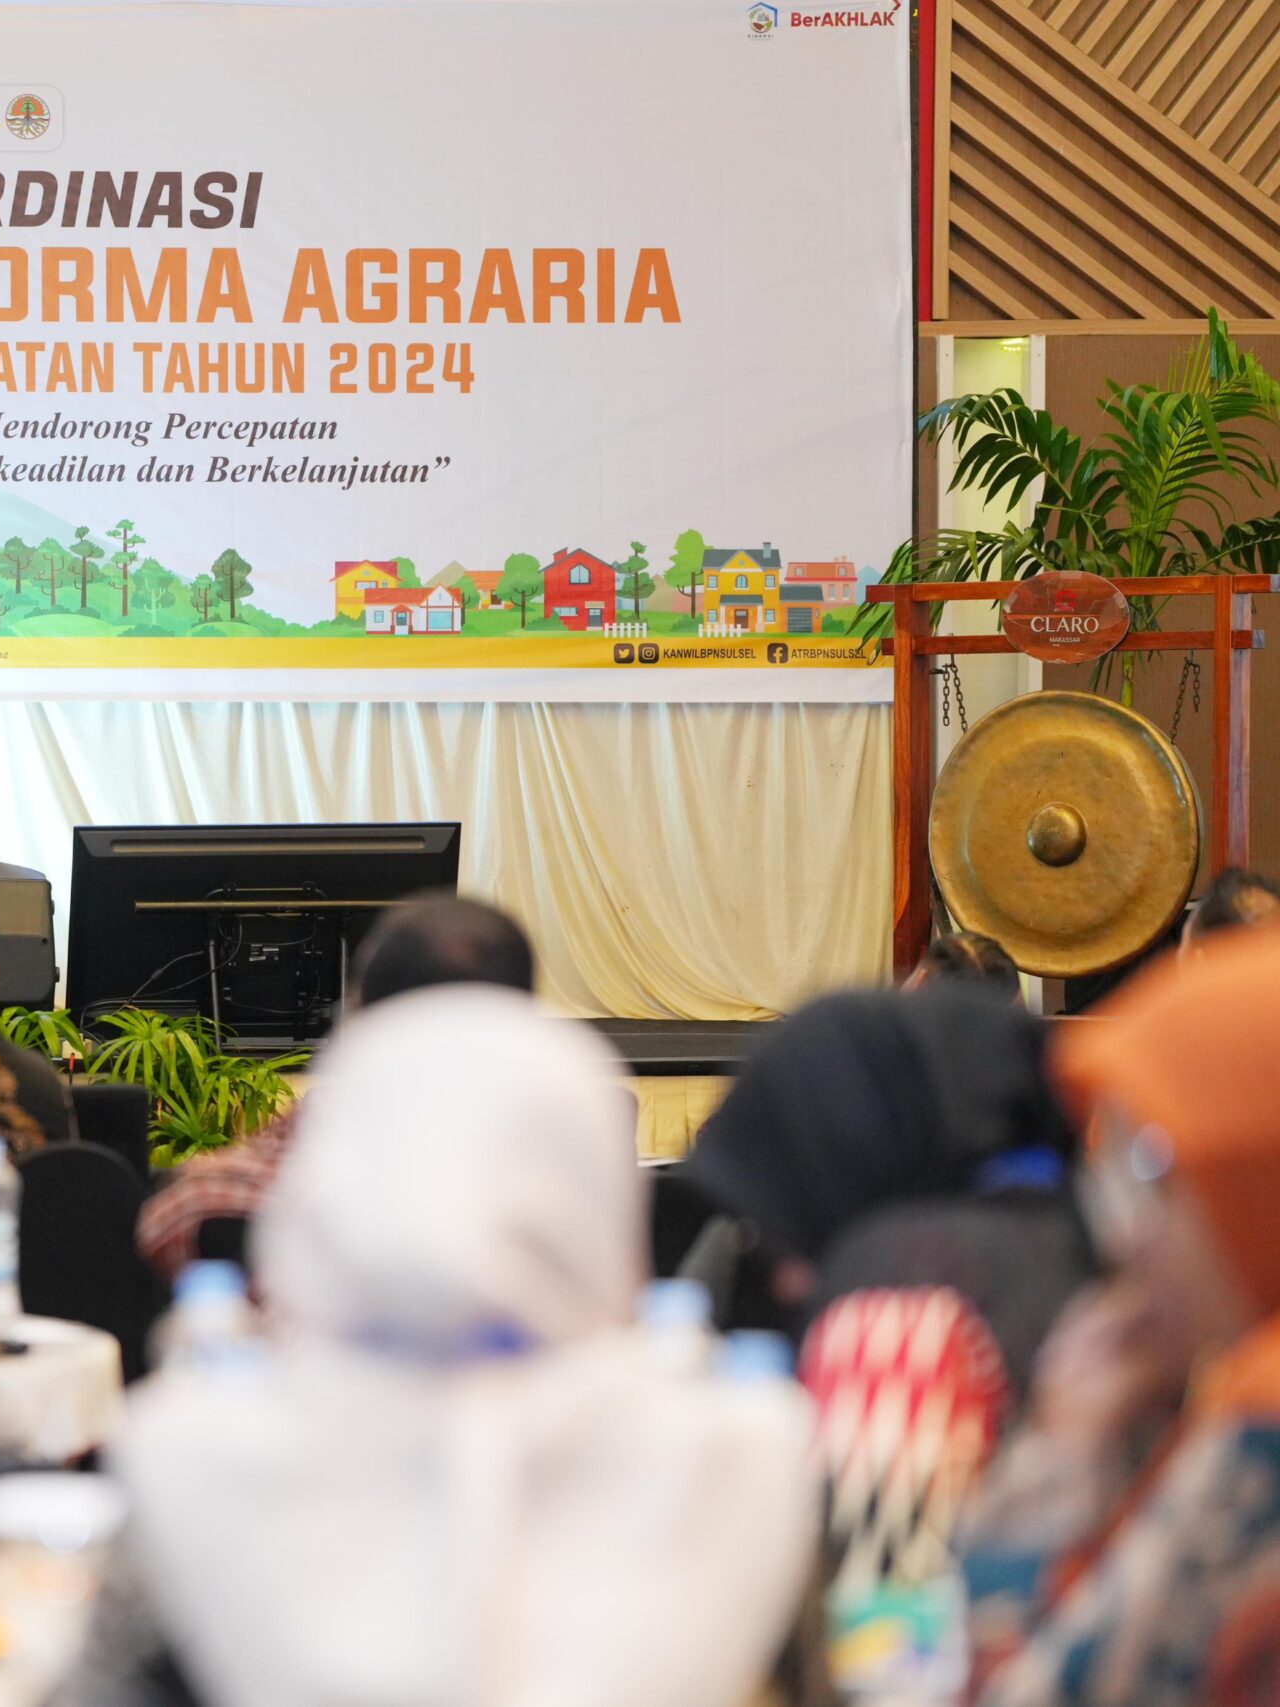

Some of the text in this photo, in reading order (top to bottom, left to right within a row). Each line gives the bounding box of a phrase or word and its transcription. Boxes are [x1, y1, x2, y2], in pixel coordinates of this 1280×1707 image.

[790, 12, 895, 28] BerAKHLAK
[282, 246, 683, 325] AGRARIA
[132, 342, 306, 395] TAHUN
[329, 342, 476, 395] 2024
[162, 412, 338, 448] Percepatan
[136, 455, 194, 483] dan
[206, 455, 451, 491] Berkelanjutan”
[1030, 616, 1100, 634] CLARO
[662, 648, 757, 660] KANWILBPNSULSEL
